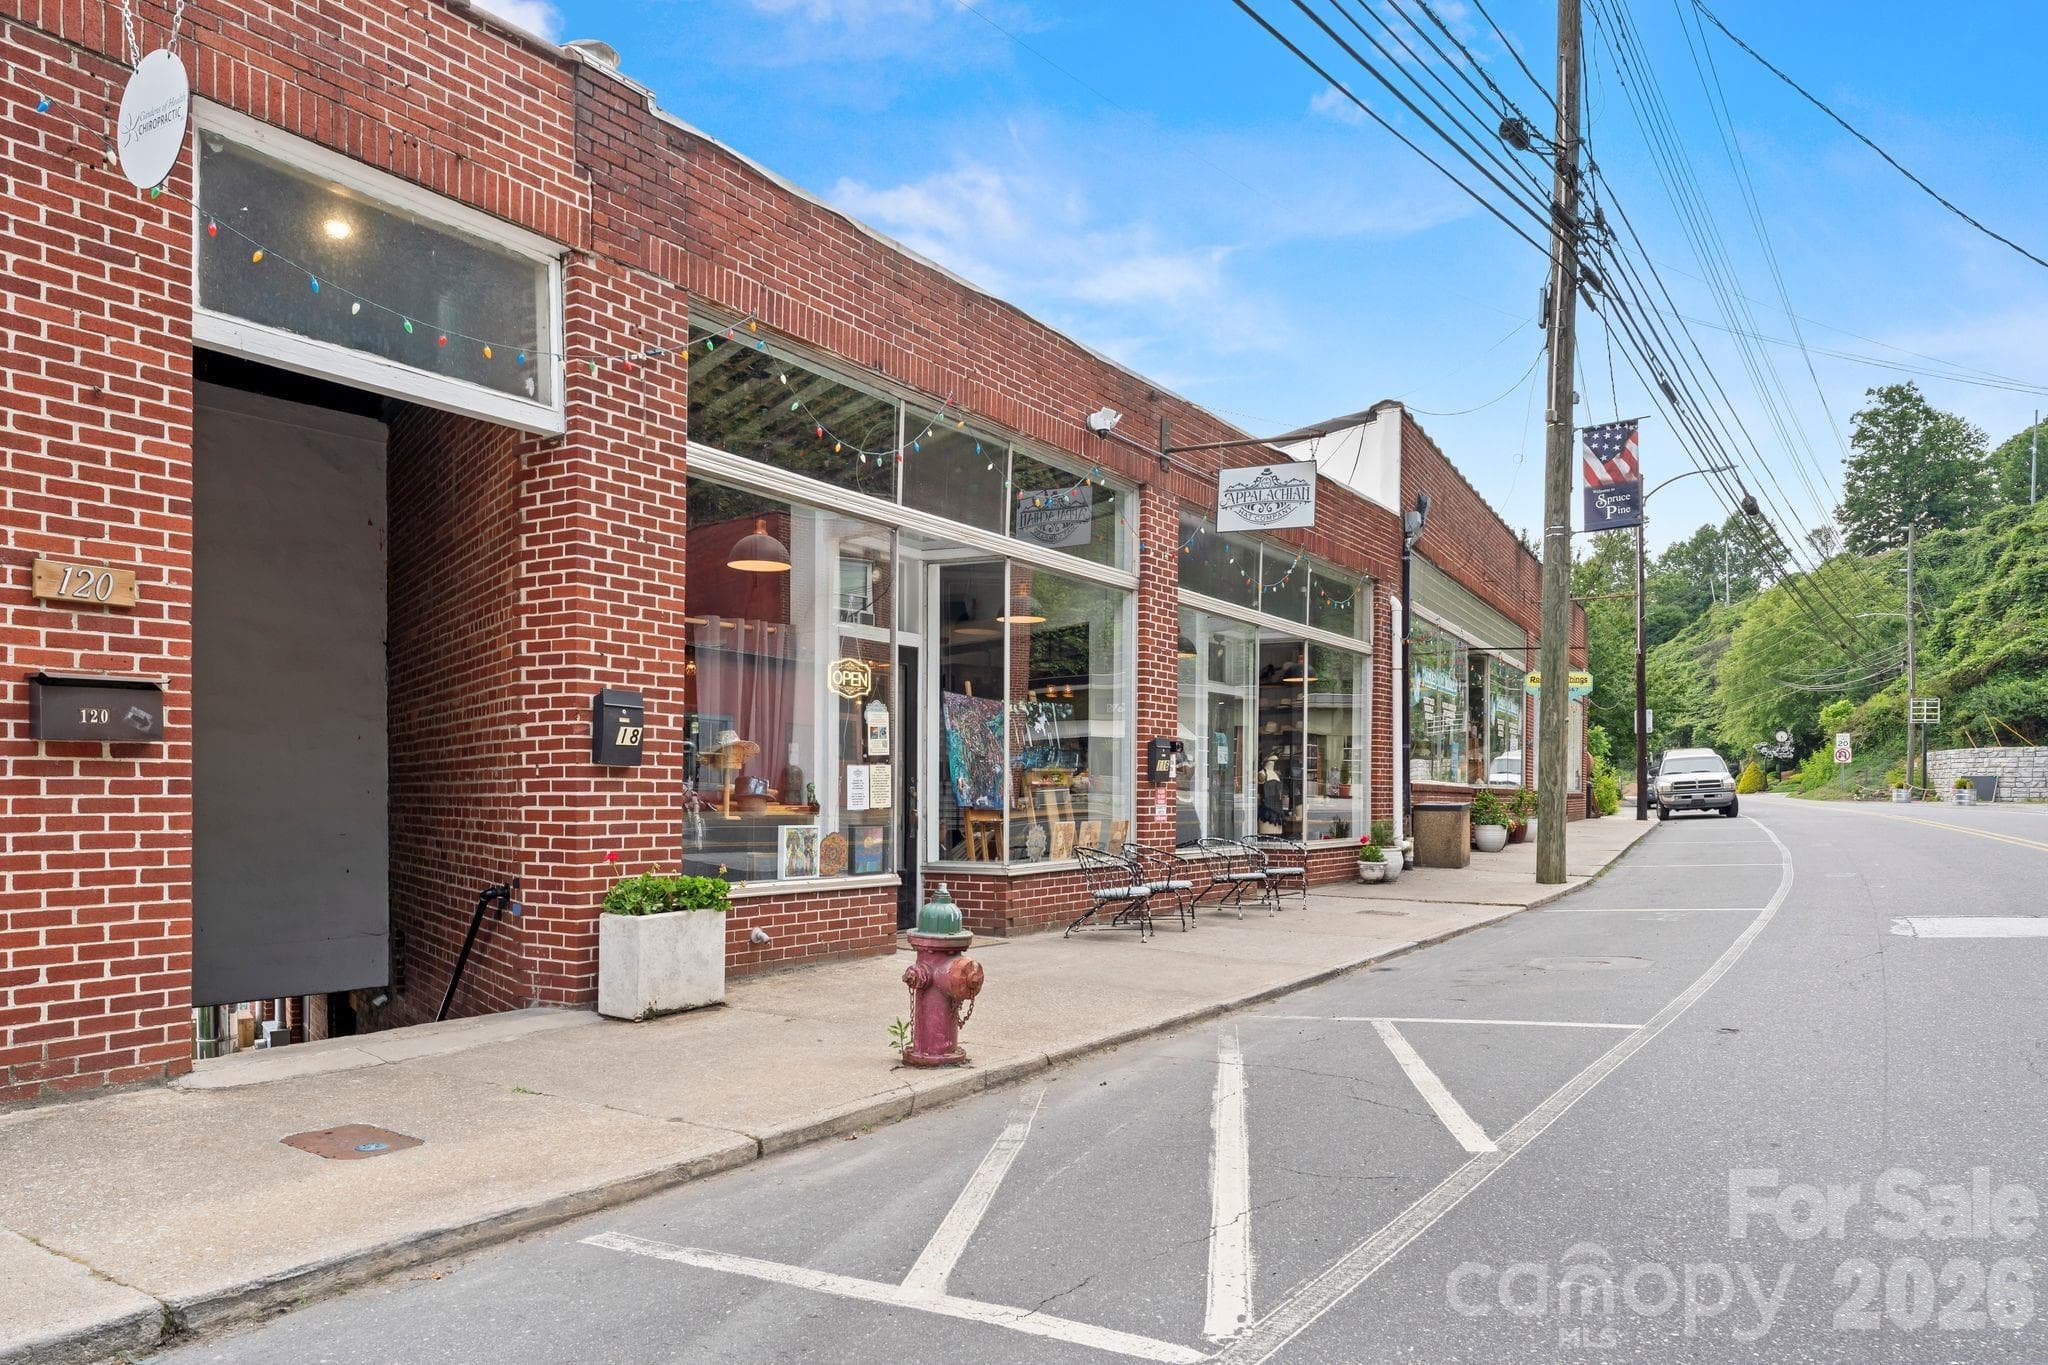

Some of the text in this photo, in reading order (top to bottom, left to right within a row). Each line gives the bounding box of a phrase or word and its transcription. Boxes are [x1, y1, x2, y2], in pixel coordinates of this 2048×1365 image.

[138, 106, 182, 135] CHIROPRACTIC
[1219, 486, 1311, 507] APPALACHIAN
[1595, 493, 1631, 508] Spruce
[1238, 506, 1293, 521] HAT COMPANY
[1606, 505, 1631, 520] Pine
[58, 566, 114, 601] 120
[832, 670, 868, 687] OPEN
[80, 709, 109, 725] 120
[621, 728, 640, 744] 18
